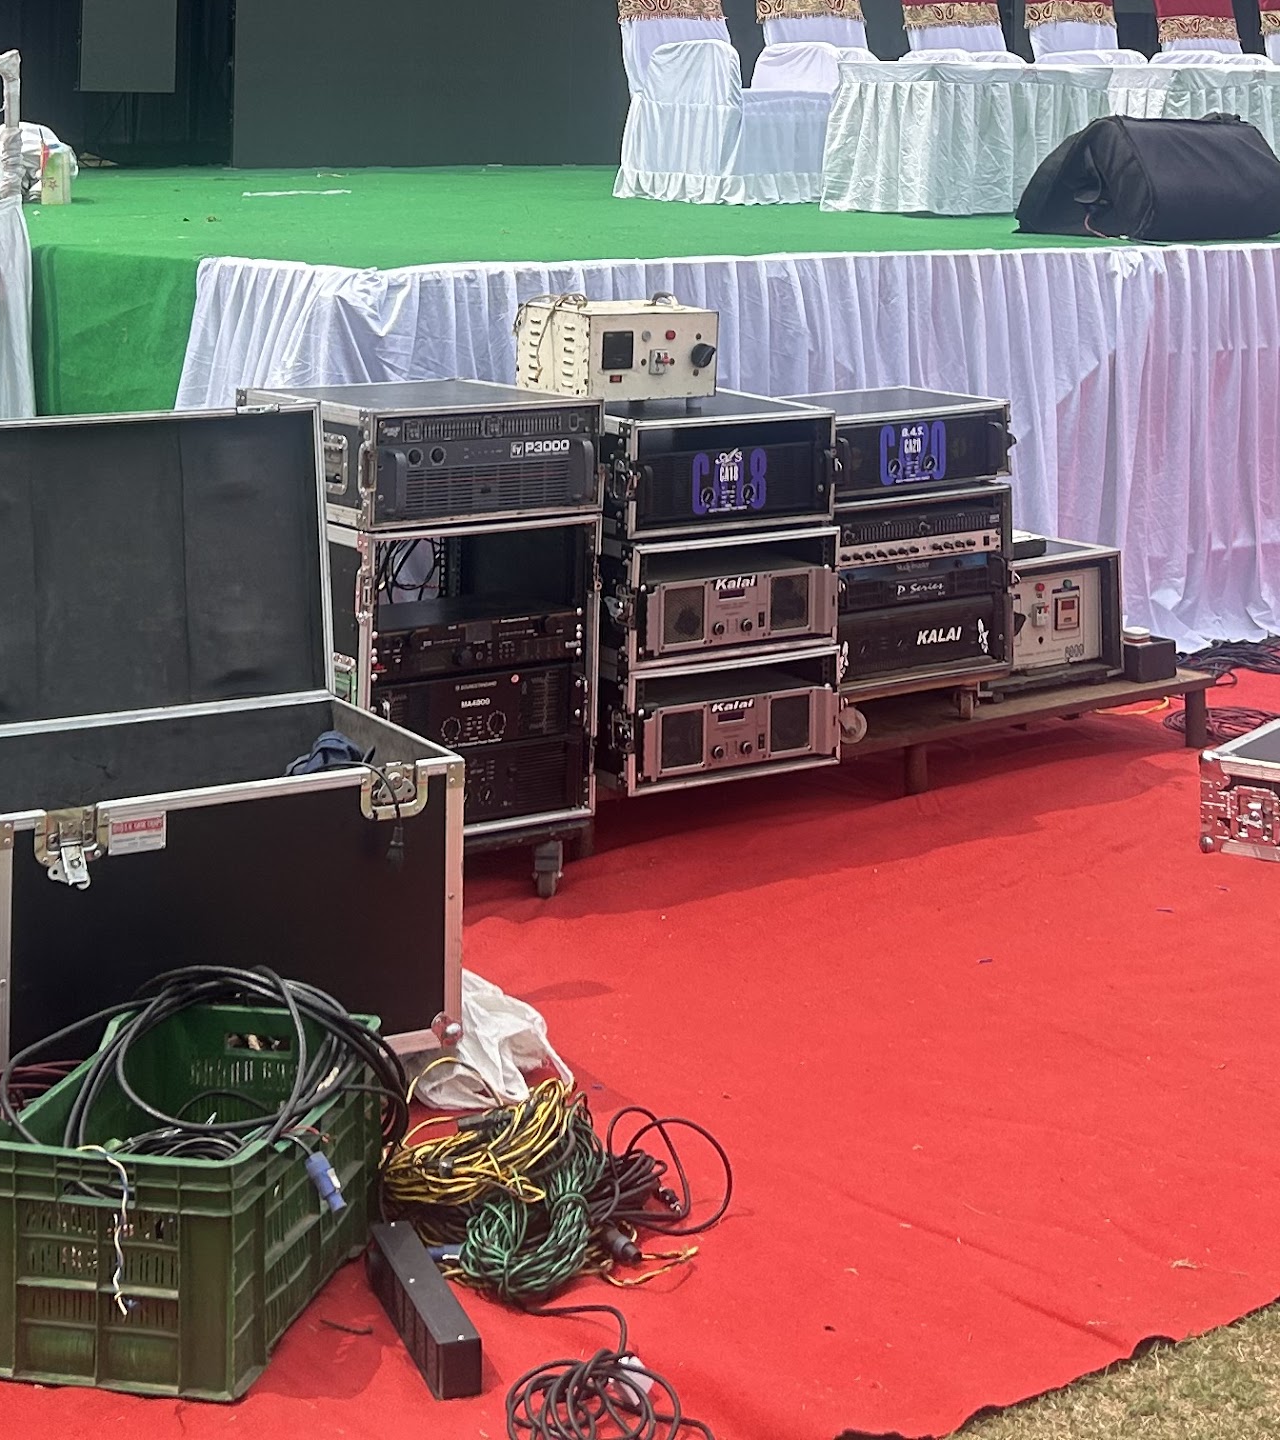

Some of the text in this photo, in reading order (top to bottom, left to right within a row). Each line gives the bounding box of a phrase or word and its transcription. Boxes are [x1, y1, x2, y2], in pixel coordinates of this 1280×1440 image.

[525, 439, 570, 453] P3000
[720, 464, 739, 482] CA18
[715, 575, 756, 591] Kalai
[897, 584, 906, 596] P
[910, 582, 944, 594] Series
[916, 626, 962, 646] KALAI
[711, 698, 754, 713] Kalai
